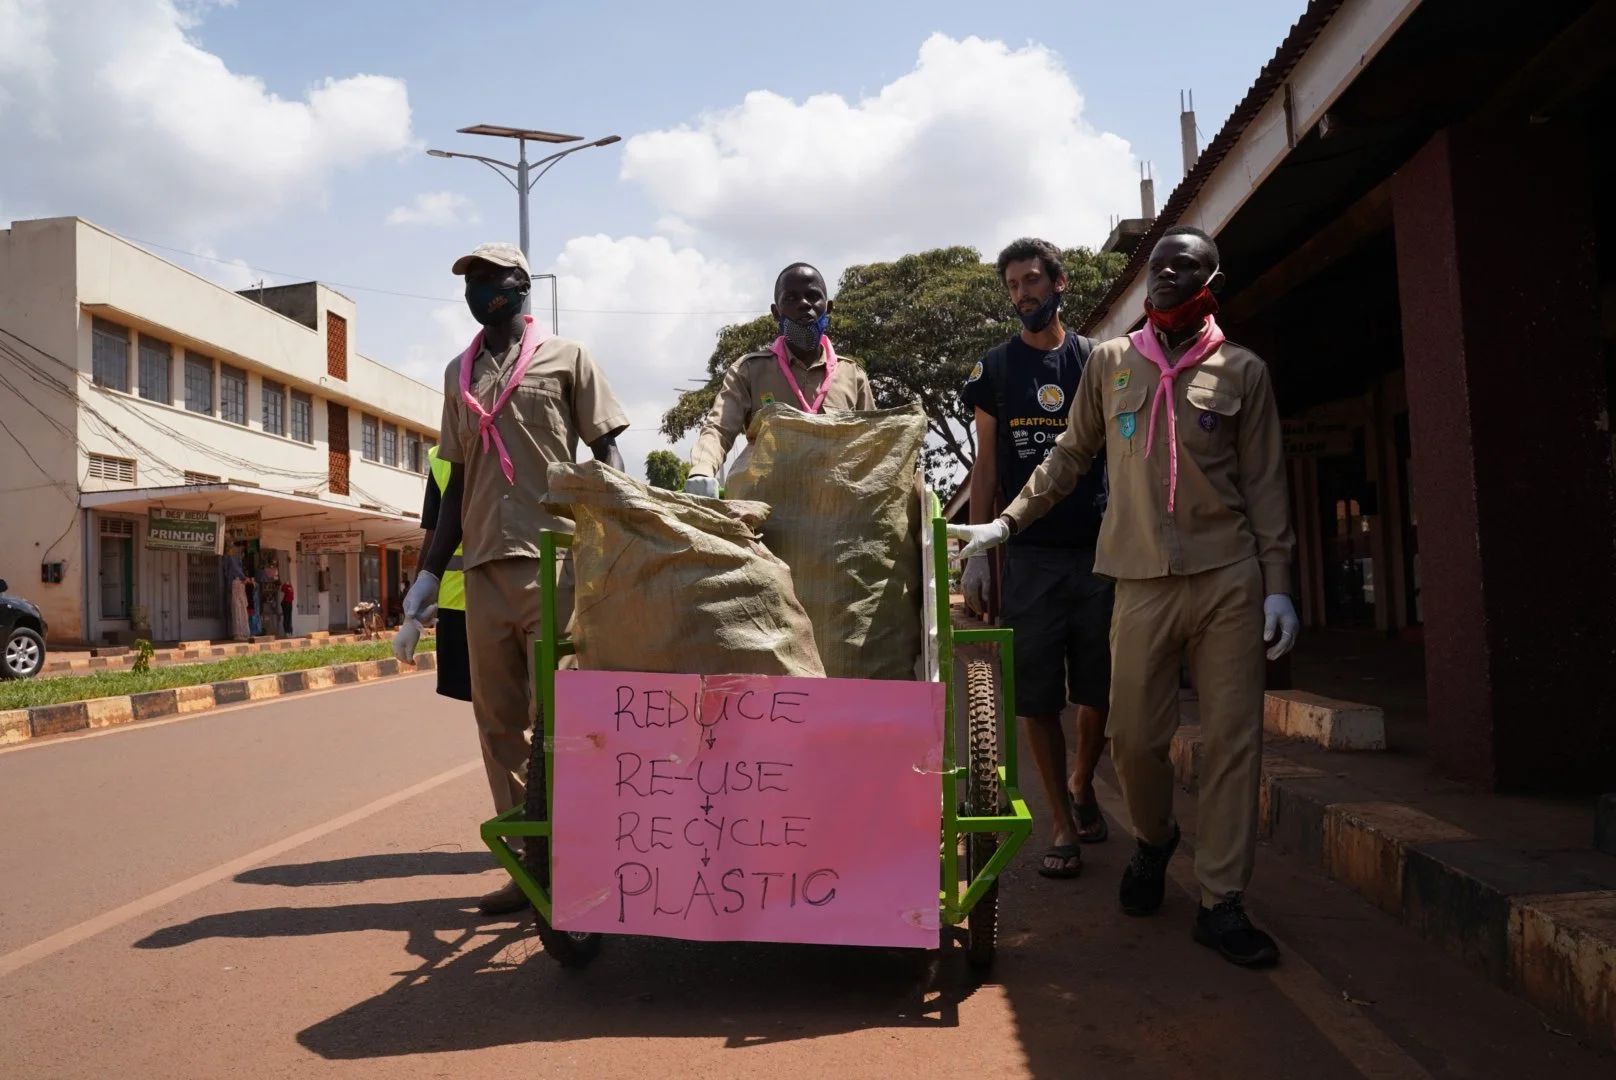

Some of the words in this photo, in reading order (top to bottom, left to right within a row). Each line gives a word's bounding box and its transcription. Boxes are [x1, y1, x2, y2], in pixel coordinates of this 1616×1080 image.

[150, 528, 215, 543] PRINTING
[184, 511, 209, 520] MEDIA
[614, 685, 809, 731] REDUCE
[615, 752, 794, 797] RE-USE
[615, 811, 812, 853] RECYCLE
[614, 862, 839, 923] PLASTIC
